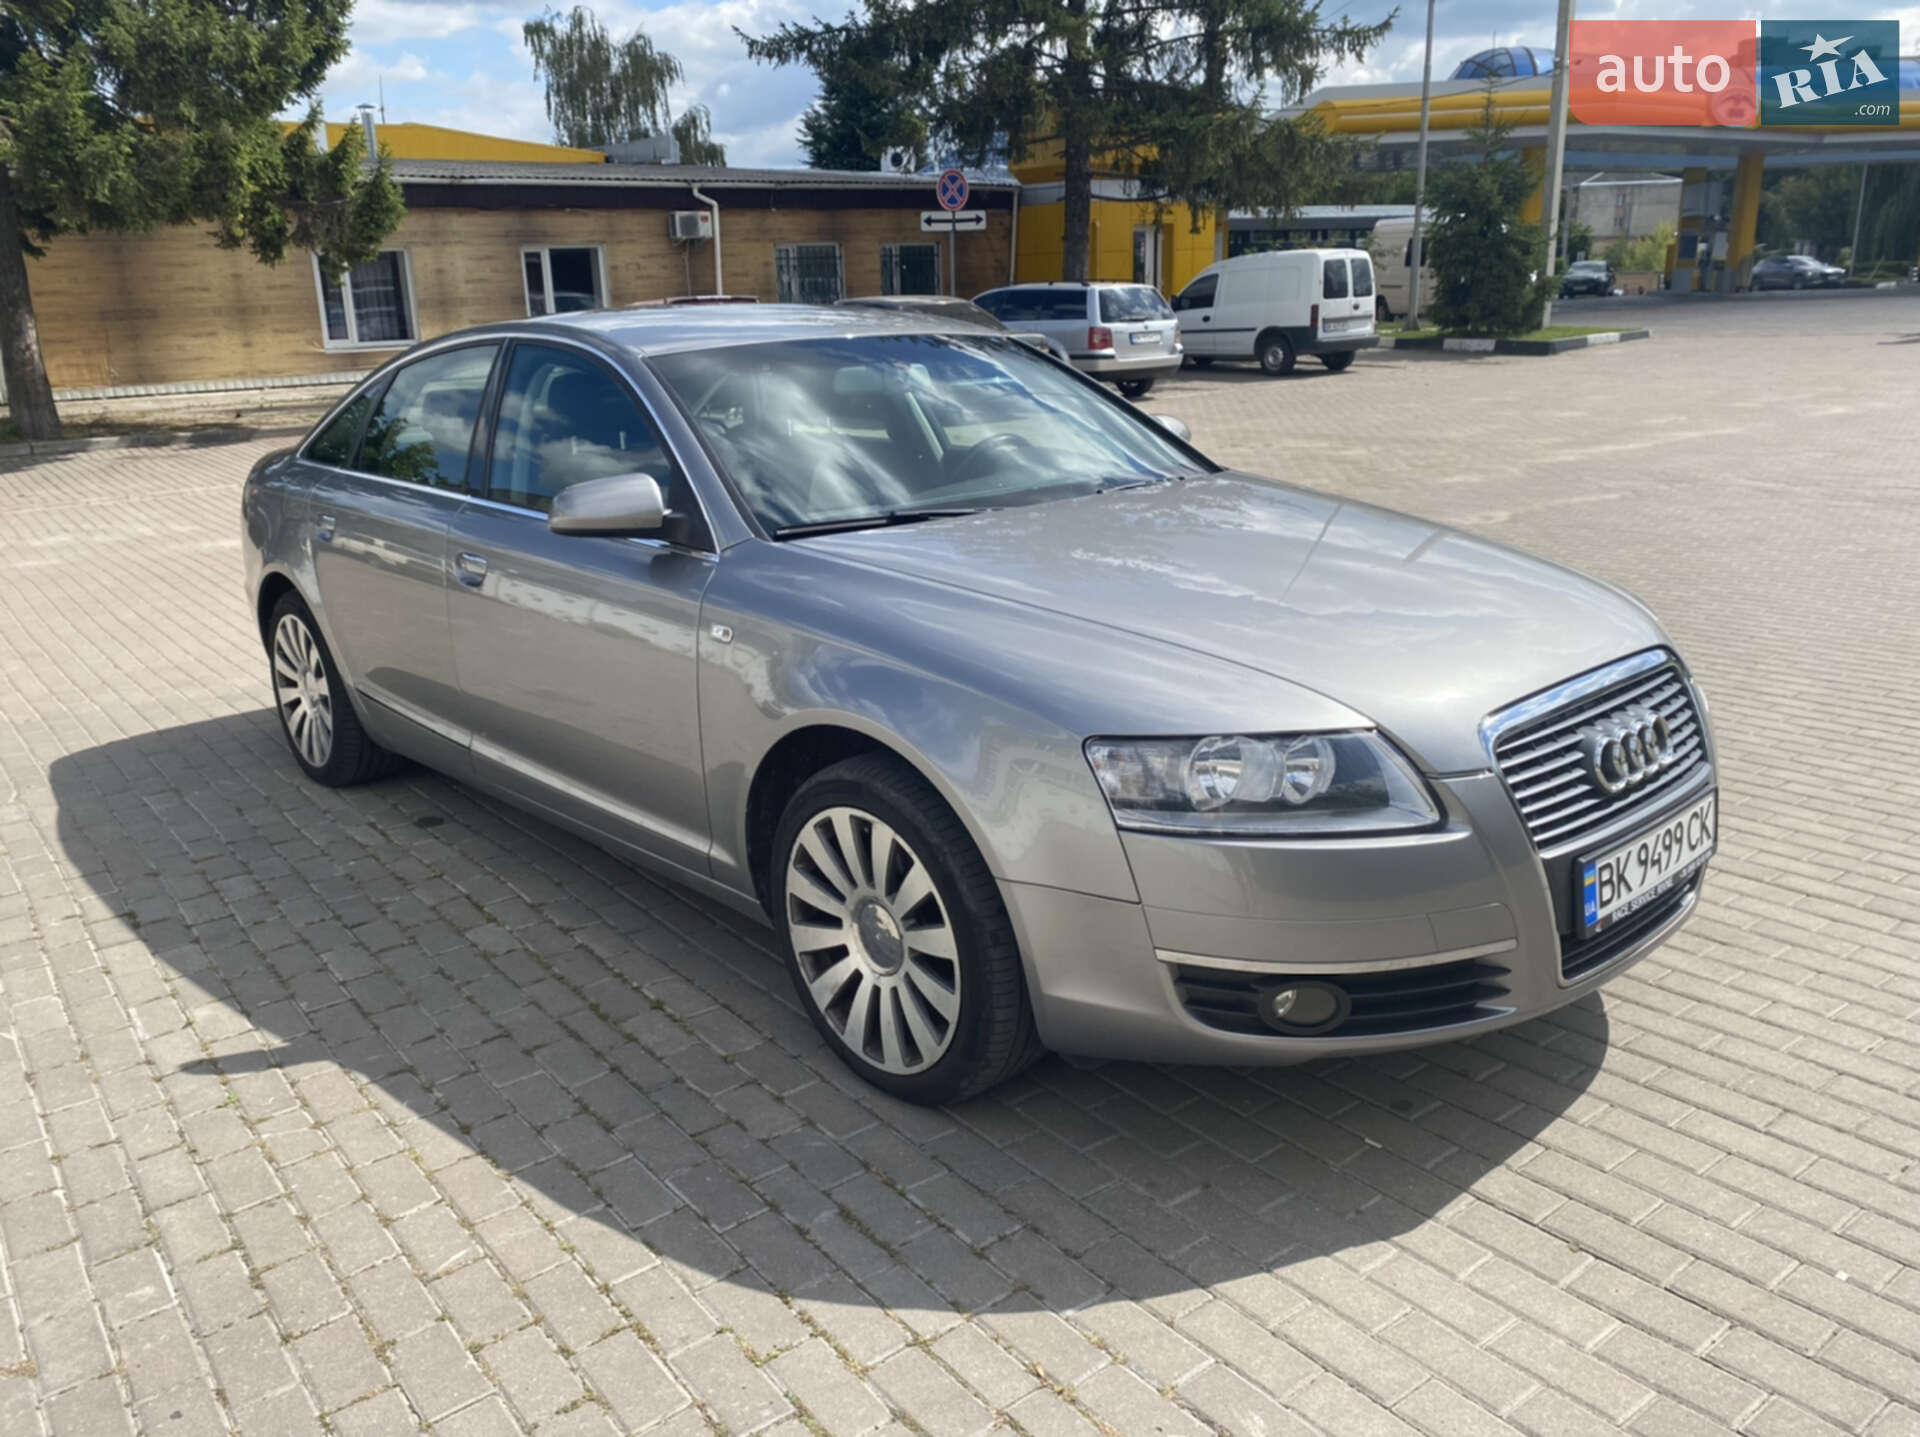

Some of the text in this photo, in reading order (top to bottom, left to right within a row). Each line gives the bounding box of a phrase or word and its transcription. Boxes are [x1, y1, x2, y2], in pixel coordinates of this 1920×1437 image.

[1598, 850, 1633, 909] BK
[1638, 821, 1684, 886] 9499
[1687, 801, 1712, 851] CK
[1584, 902, 1596, 917] UA
